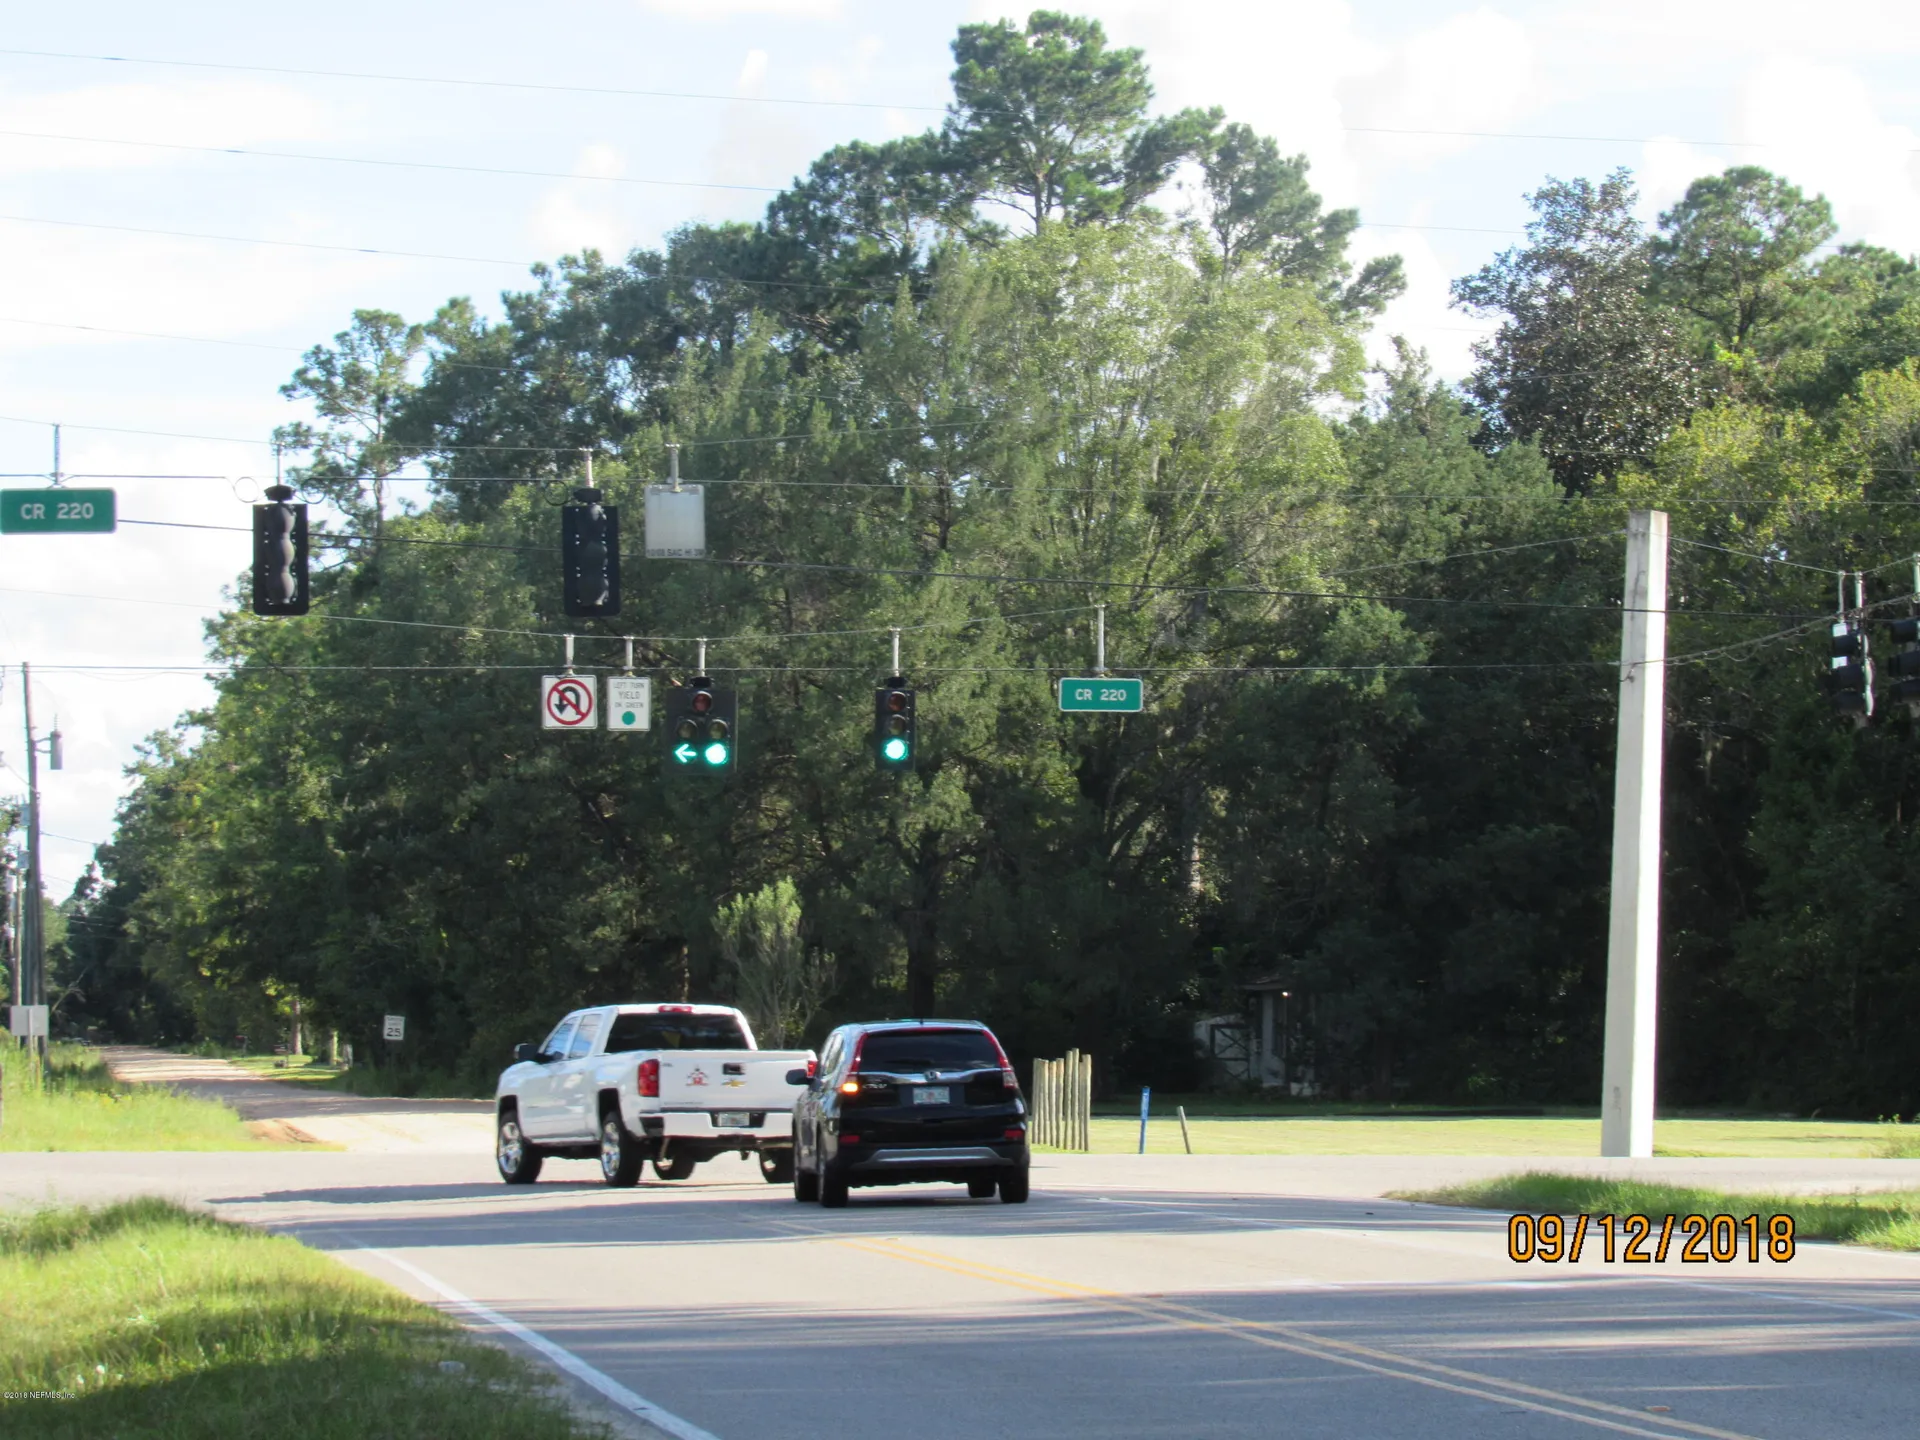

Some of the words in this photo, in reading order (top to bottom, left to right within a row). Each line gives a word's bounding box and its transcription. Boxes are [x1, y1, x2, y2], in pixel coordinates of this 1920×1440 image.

[20, 503, 45, 519] CR
[56, 502, 94, 519] 220
[618, 691, 641, 699] YIELD
[1075, 688, 1093, 701] CR
[1100, 688, 1127, 701] 220
[386, 1027, 402, 1037] 25
